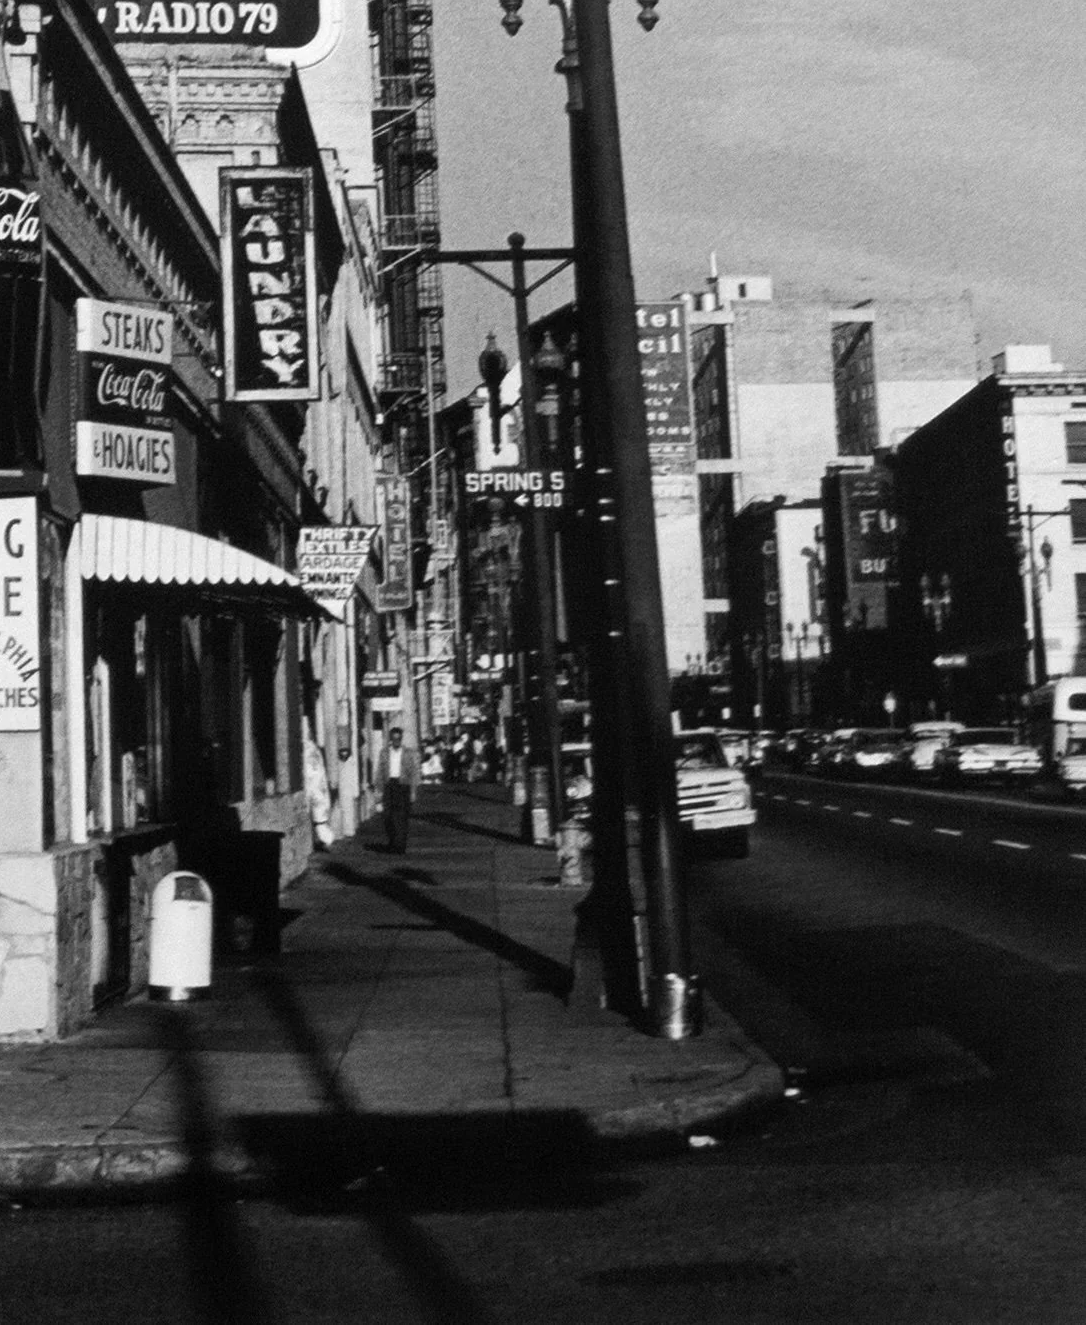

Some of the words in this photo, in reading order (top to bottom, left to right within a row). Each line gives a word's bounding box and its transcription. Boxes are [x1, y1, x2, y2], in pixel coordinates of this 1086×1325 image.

[115, 1, 235, 34] RADIO
[238, 2, 278, 34] 79
[236, 186, 305, 385] LAUNDRY
[101, 311, 164, 354] STEAKS
[97, 363, 165, 412] Coca-Cola
[102, 431, 170, 475] HOAGIES
[465, 472, 543, 492] SPRING
[387, 480, 406, 582] HOTEL
